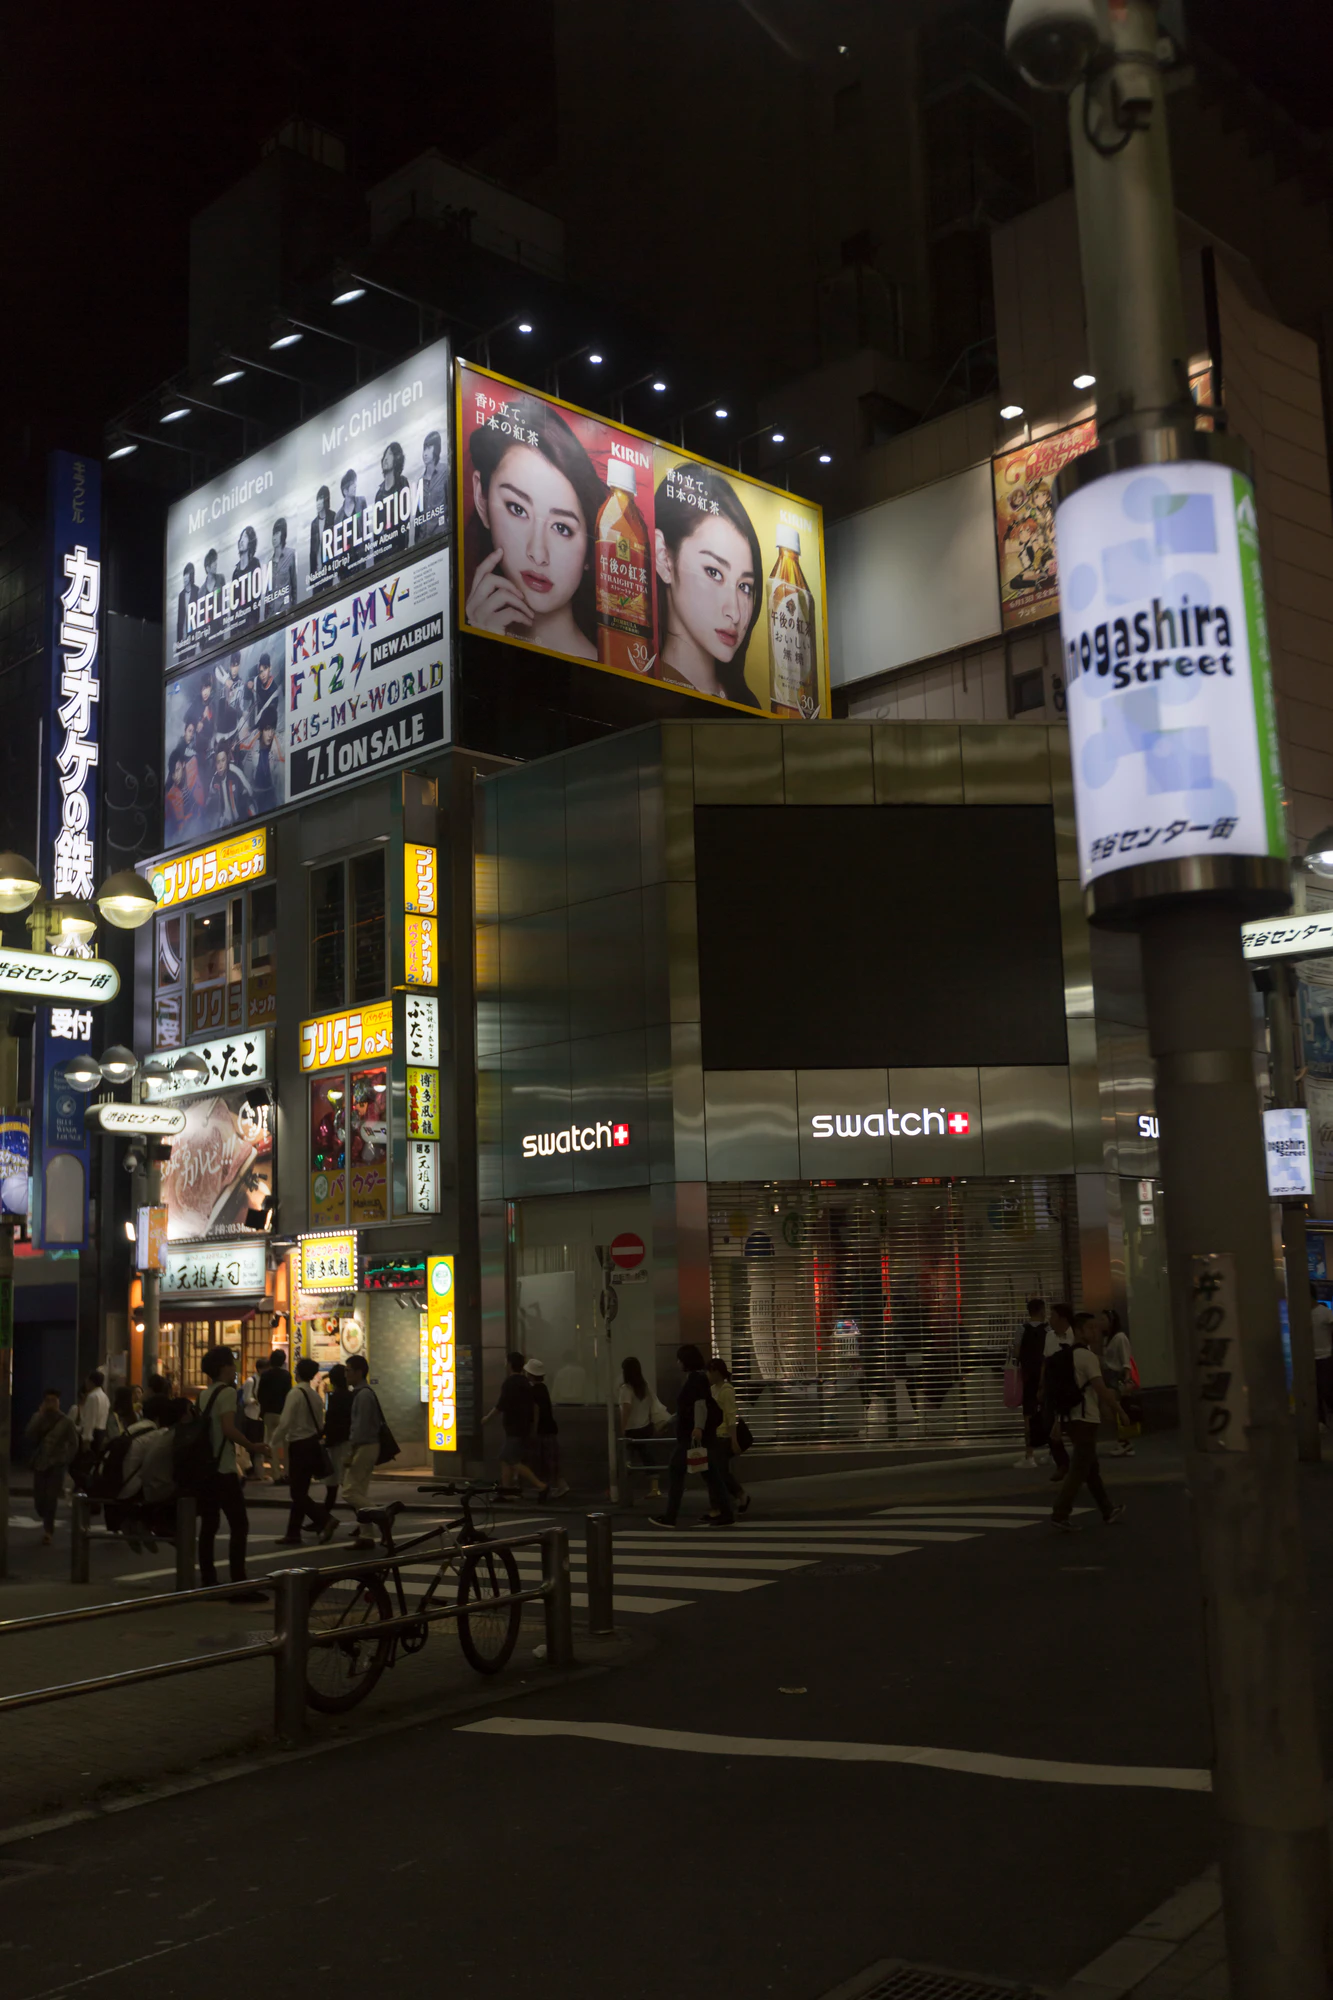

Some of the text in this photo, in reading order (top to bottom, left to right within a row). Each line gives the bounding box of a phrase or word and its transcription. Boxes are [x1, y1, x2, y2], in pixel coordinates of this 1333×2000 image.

[321, 380, 423, 455] Mr.Children
[474, 392, 527, 425] 香り立て。
[475, 410, 539, 447] 日本の紅茶
[611, 441, 650, 469] KIRIN
[666, 467, 709, 496] 香り立て。
[188, 470, 273, 534] Mr.Children
[666, 484, 721, 516] 日本の紅茶
[321, 478, 424, 563] REFLECTION
[364, 504, 445, 552] New Album 6.4 RELEASE
[779, 509, 813, 533] KIRIN
[600, 555, 648, 584] 午後の紅茶
[600, 573, 648, 594] STRAIGHT TEA
[187, 560, 273, 633] REFLECTION
[235, 606, 252, 620] Album
[263, 585, 290, 605] RELEASE
[290, 577, 410, 666] KIS-MY-
[771, 609, 812, 637] 午後の紅茶
[372, 618, 441, 663] NEW ALBUM
[633, 642, 648, 660] 30
[775, 631, 810, 650] おいしい
[1064, 598, 1233, 684] ogashira
[1113, 652, 1235, 690] Street
[290, 660, 444, 747] KIS-MY-WORLD
[801, 695, 814, 711] 30
[307, 713, 425, 786] 7.1 ON SALE
[415, 848, 435, 914] プリクラ
[1242, 925, 1333, 948] 渋谷センター
[51, 1008, 93, 1041] 受付
[302, 1013, 393, 1070] プリクラのメ
[522, 1120, 613, 1158] swatch
[812, 1108, 946, 1137] swatch
[177, 1262, 240, 1289] 元祖寿司
[435, 1433, 452, 1446] 3F
